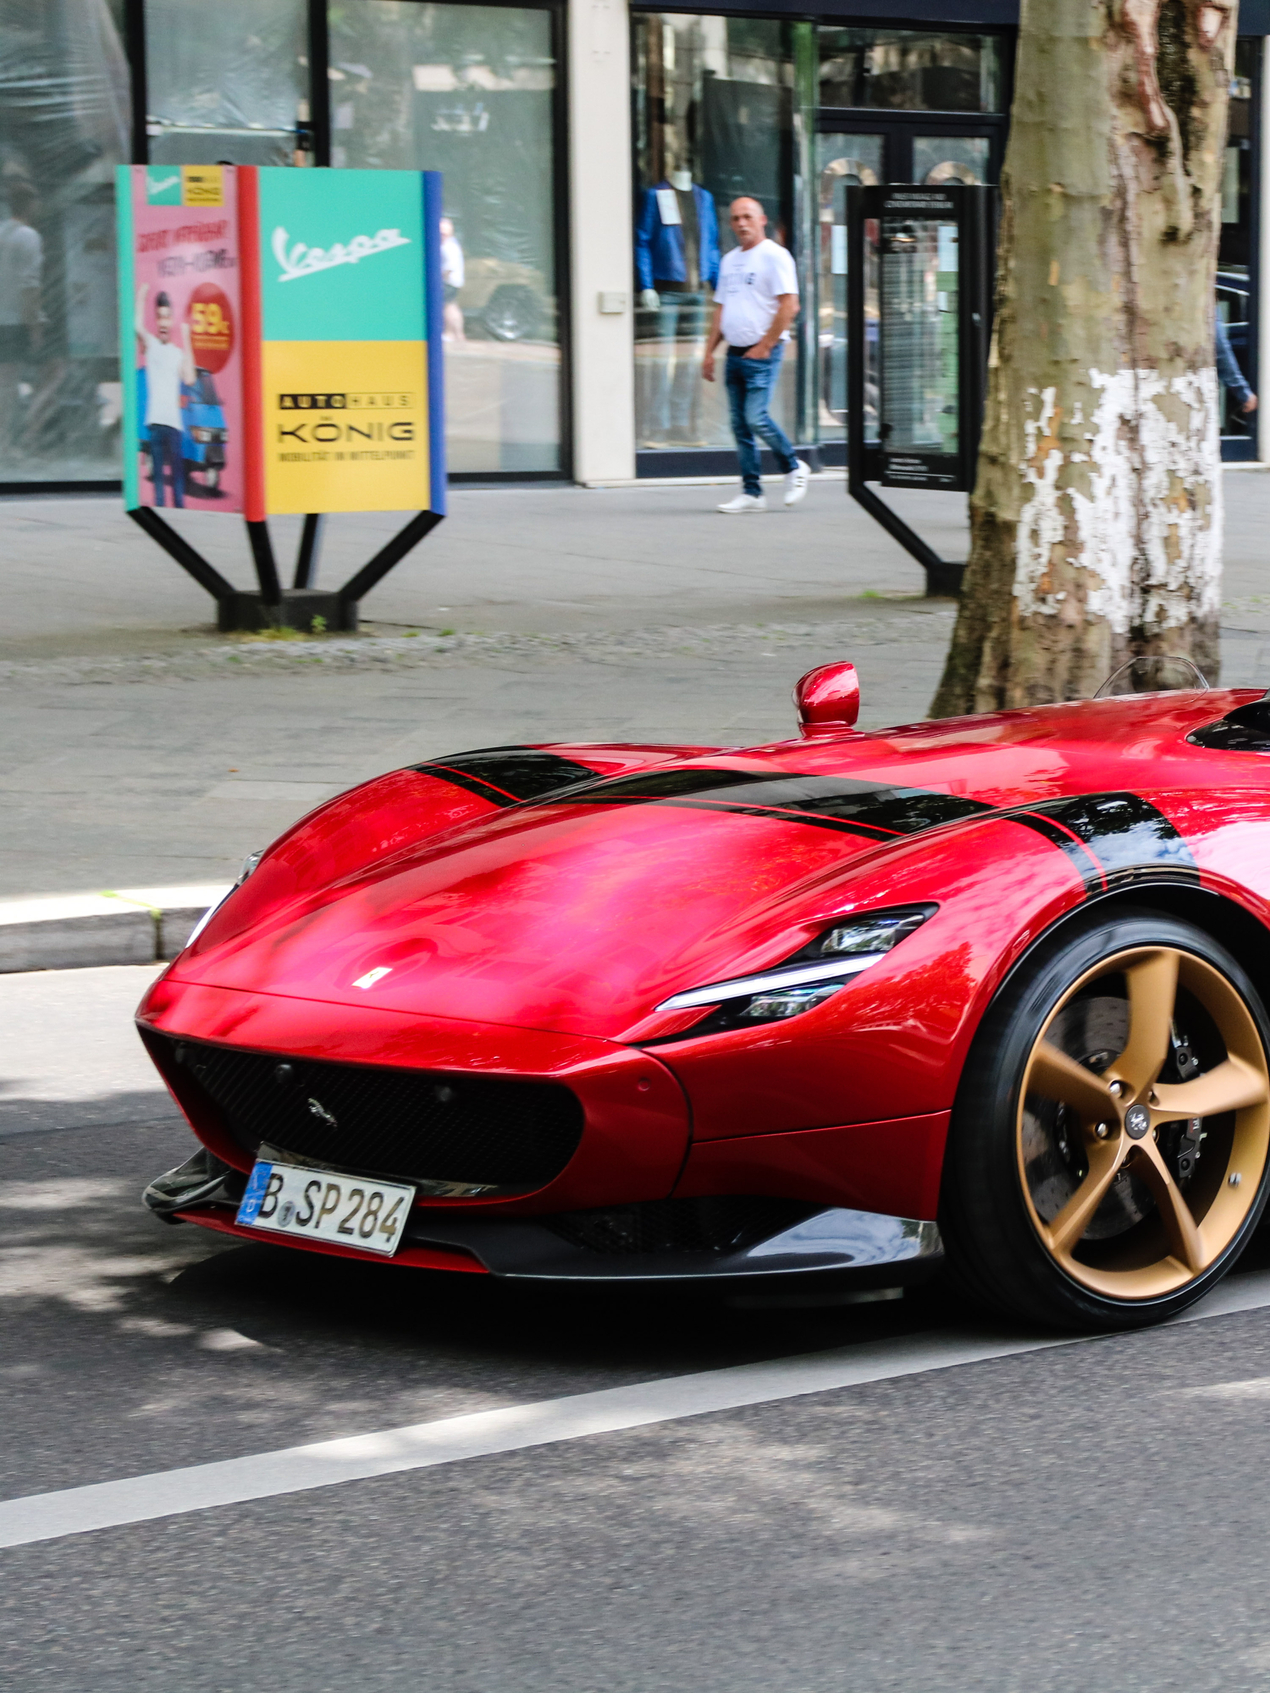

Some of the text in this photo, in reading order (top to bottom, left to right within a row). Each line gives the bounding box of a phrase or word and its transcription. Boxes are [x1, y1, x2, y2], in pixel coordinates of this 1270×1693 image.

[271, 226, 411, 282] Vespa
[277, 415, 414, 443] KÖNIG
[258, 1173, 284, 1218] B
